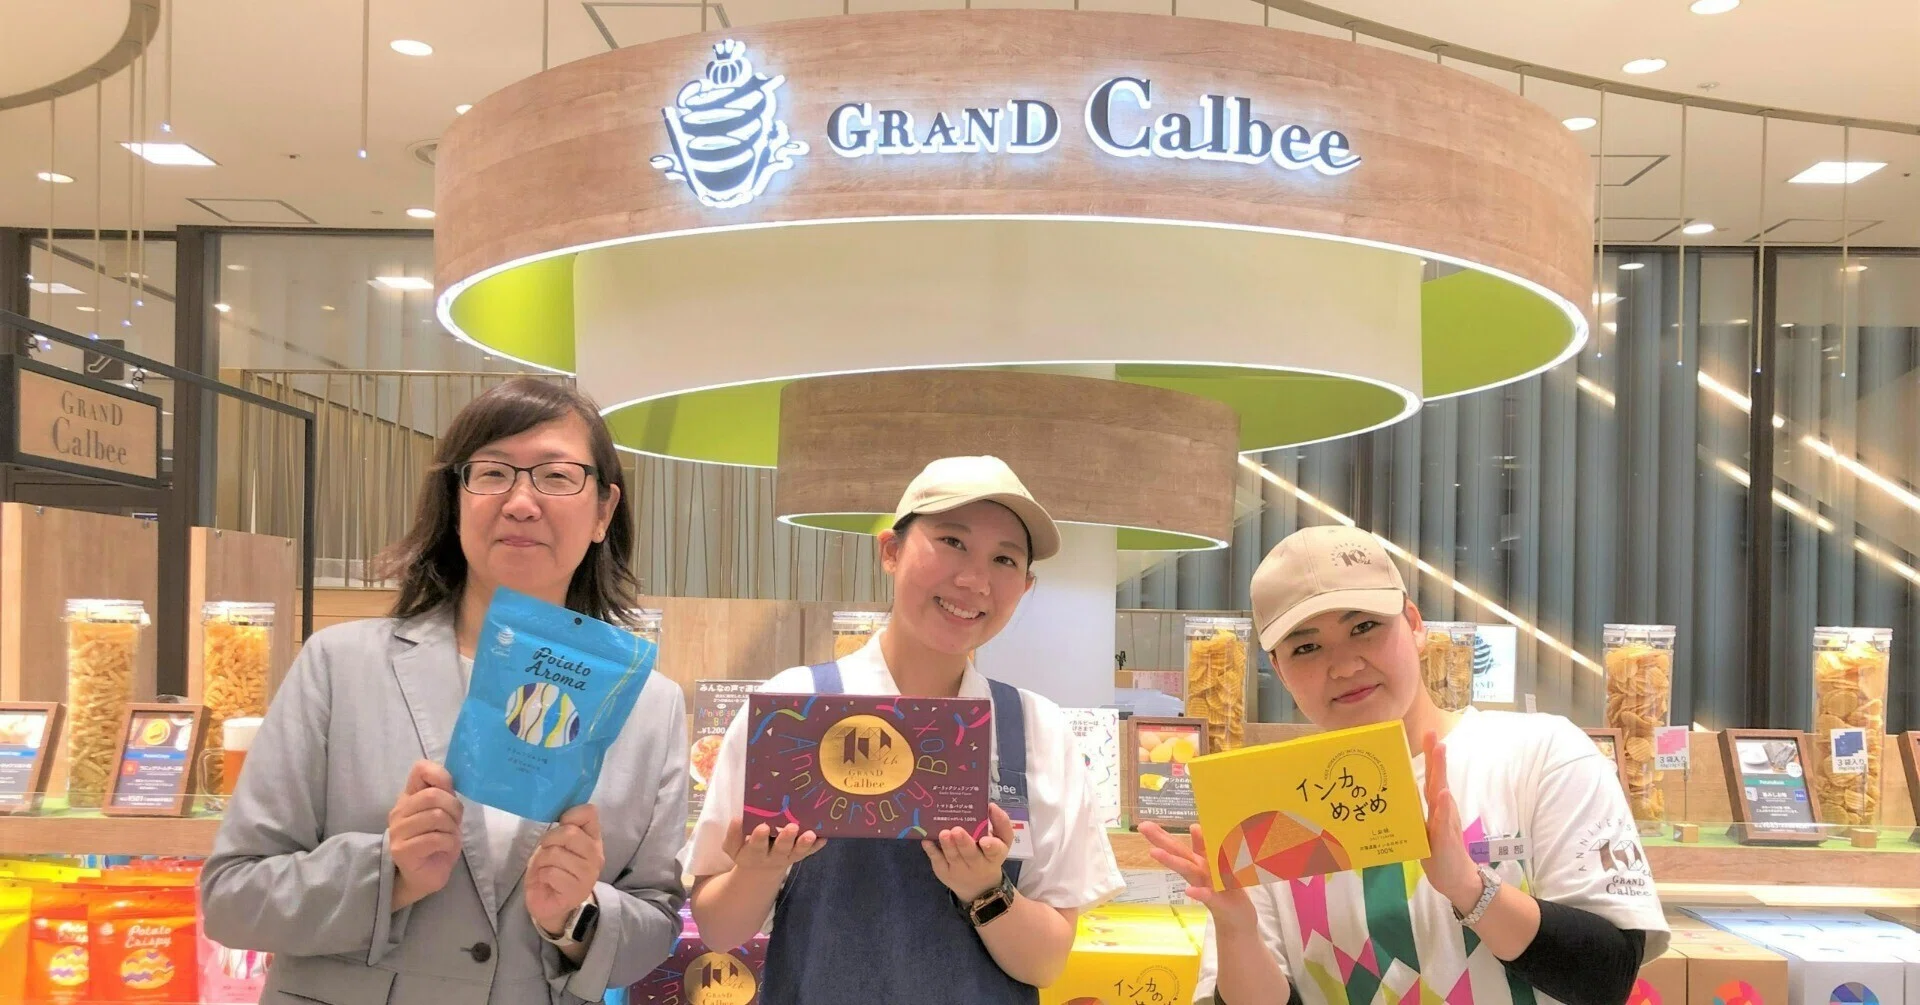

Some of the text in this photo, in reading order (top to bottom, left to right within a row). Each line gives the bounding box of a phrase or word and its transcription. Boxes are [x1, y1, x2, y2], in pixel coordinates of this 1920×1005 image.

[827, 76, 1362, 177] GRAND Calbee
[60, 390, 124, 427] GRAND
[51, 416, 129, 465] Calbee
[532, 646, 592, 677] Potato
[524, 661, 587, 691] Aroma
[777, 719, 948, 826] Anniversary Box
[844, 777, 885, 788] Calbee
[848, 769, 883, 777] GRAND
[1296, 767, 1367, 802] インカの
[1330, 794, 1387, 822] めざめ
[1606, 882, 1652, 897] Calbee
[1612, 875, 1646, 887] GRAND
[124, 935, 172, 949] Crispy
[127, 924, 172, 936] Potato
[1113, 977, 1163, 1002] インカの
